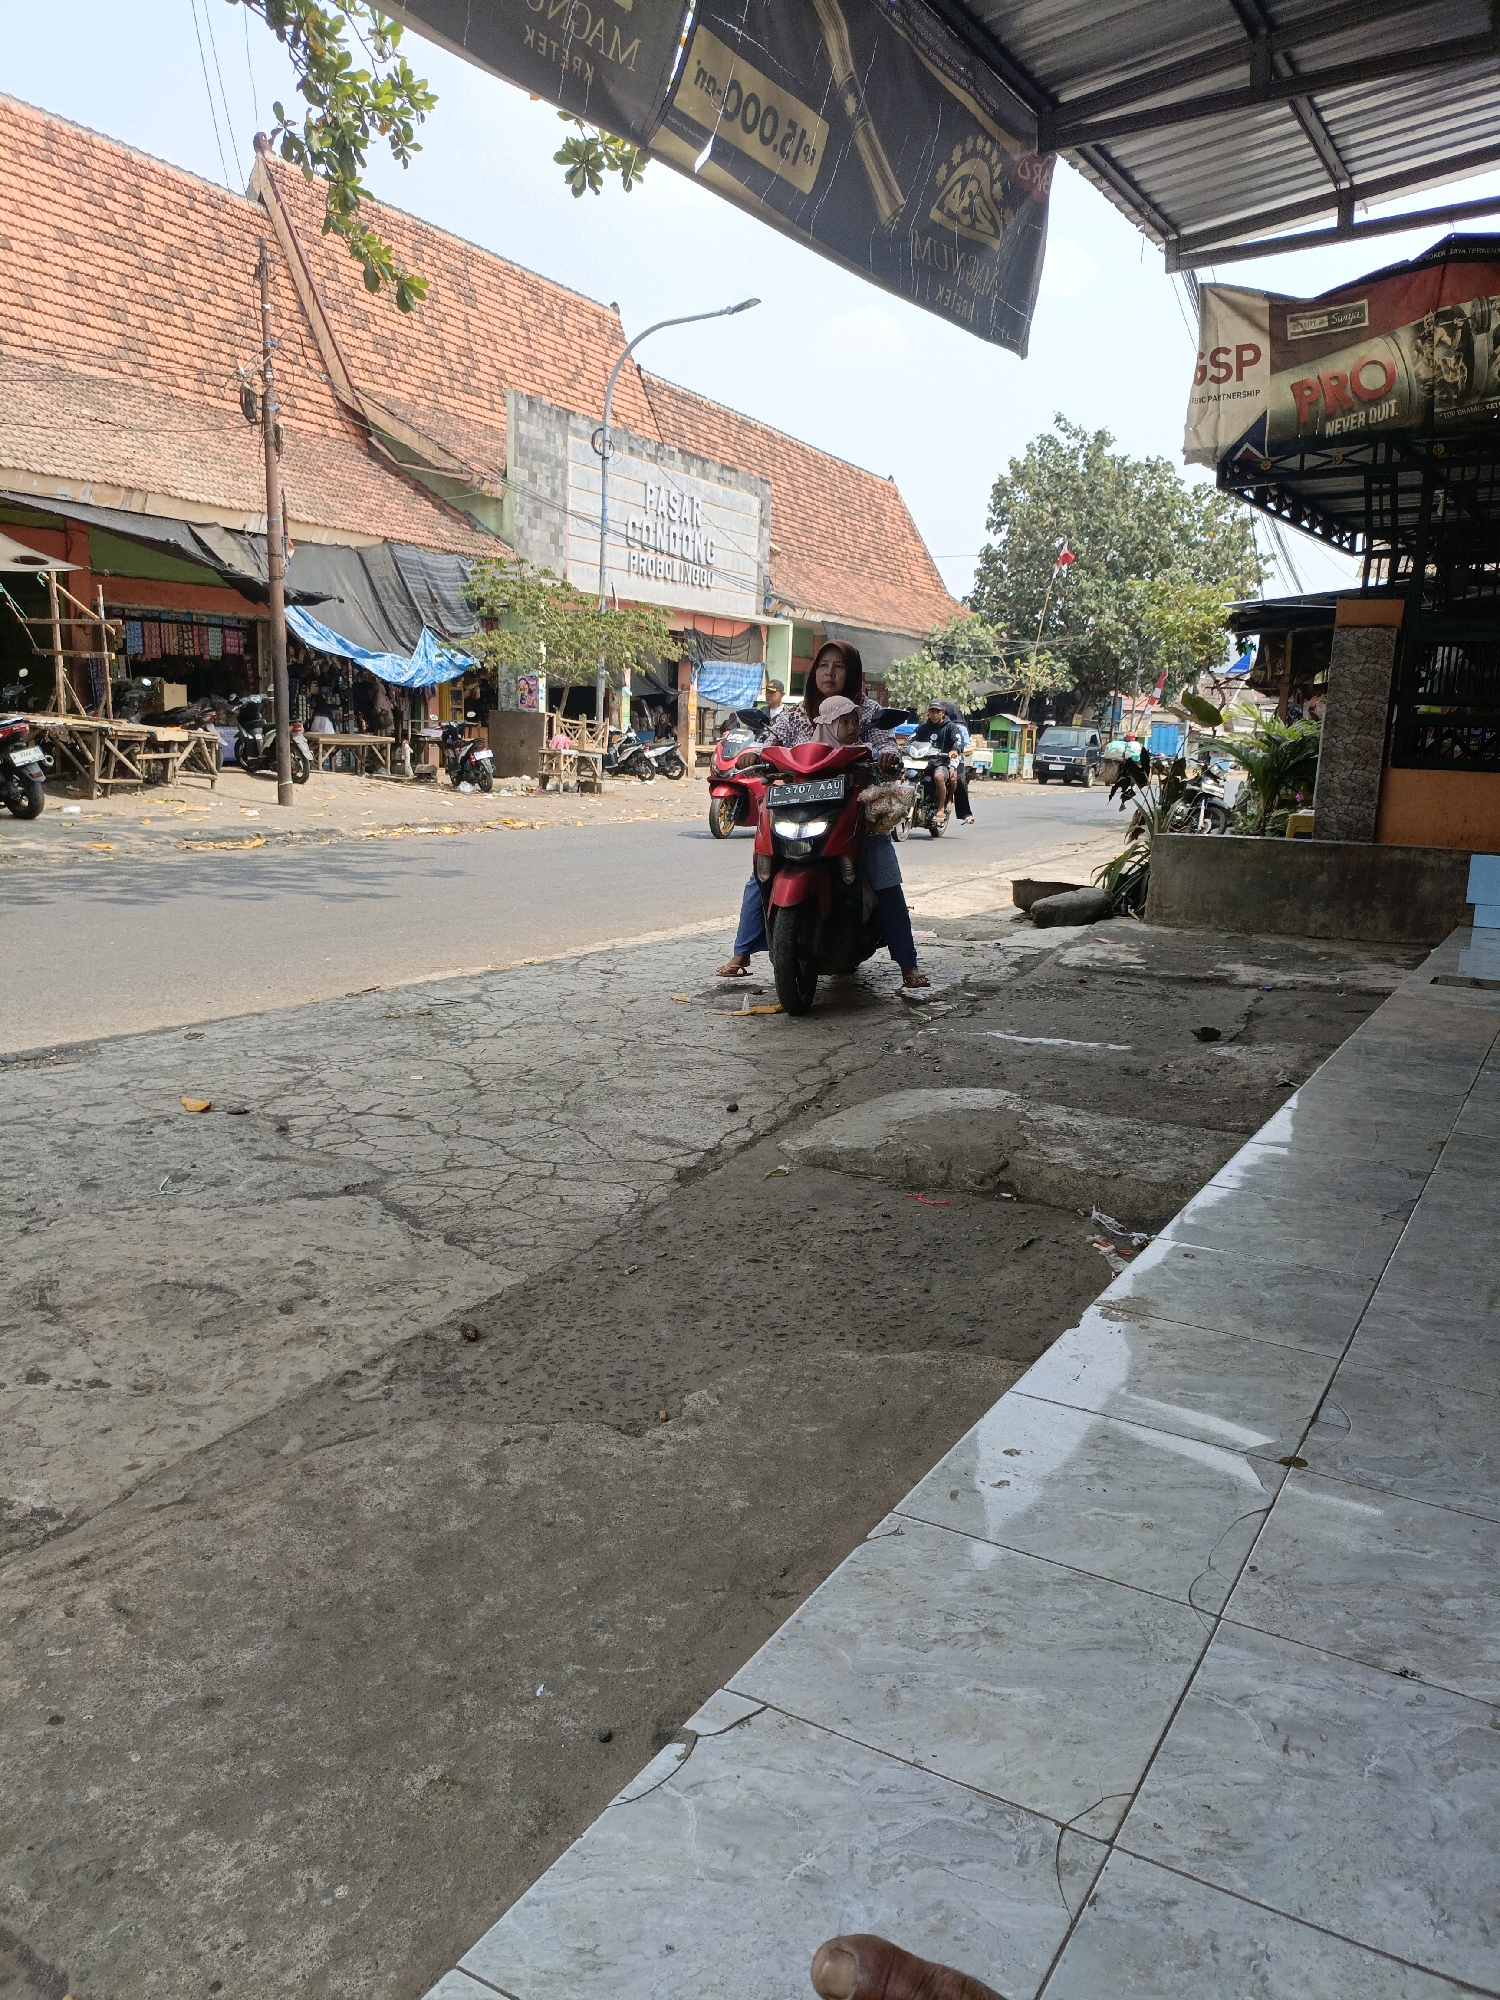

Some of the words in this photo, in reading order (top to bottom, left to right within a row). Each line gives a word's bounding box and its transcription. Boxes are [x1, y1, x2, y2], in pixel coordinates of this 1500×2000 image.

[1331, 312, 1363, 325] Surya
[1208, 389, 1260, 402] PARTNERSHIP
[1290, 356, 1396, 423] PRO
[1325, 409, 1366, 438] NEVER
[1368, 400, 1399, 425] QUIT.
[645, 482, 701, 527] PASAR
[629, 551, 714, 586] PROBOLINGGO
[773, 788, 780, 796] L
[785, 785, 813, 794] 3707
[819, 781, 840, 791] AAU
